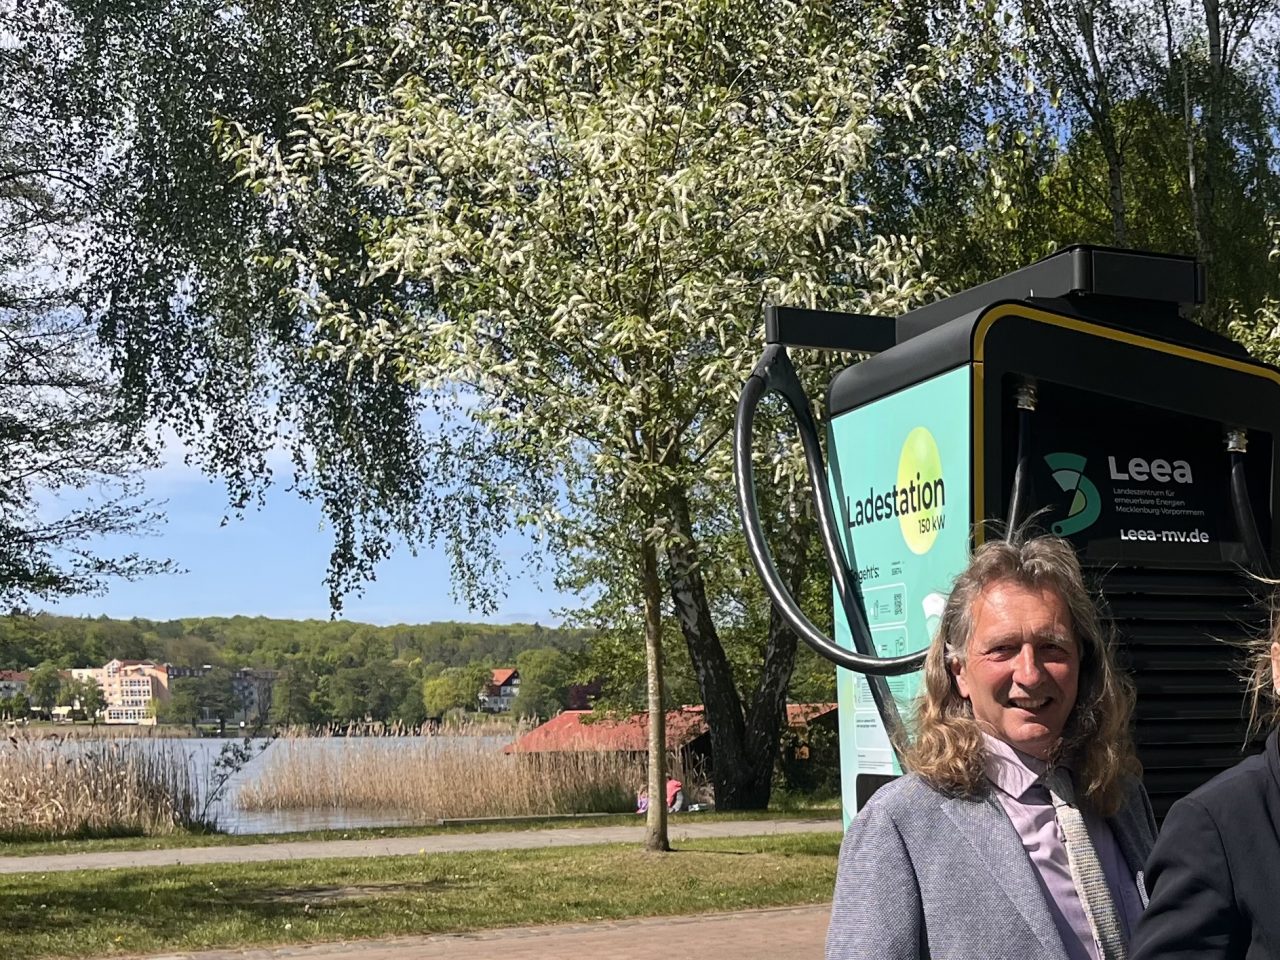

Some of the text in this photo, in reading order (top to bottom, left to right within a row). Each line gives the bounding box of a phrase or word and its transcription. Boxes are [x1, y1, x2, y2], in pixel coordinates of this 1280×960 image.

[1108, 456, 1193, 484] Leea
[847, 472, 945, 529] Ladestation
[918, 514, 945, 534] 150 kW
[1120, 528, 1210, 543] Leea-mv.de
